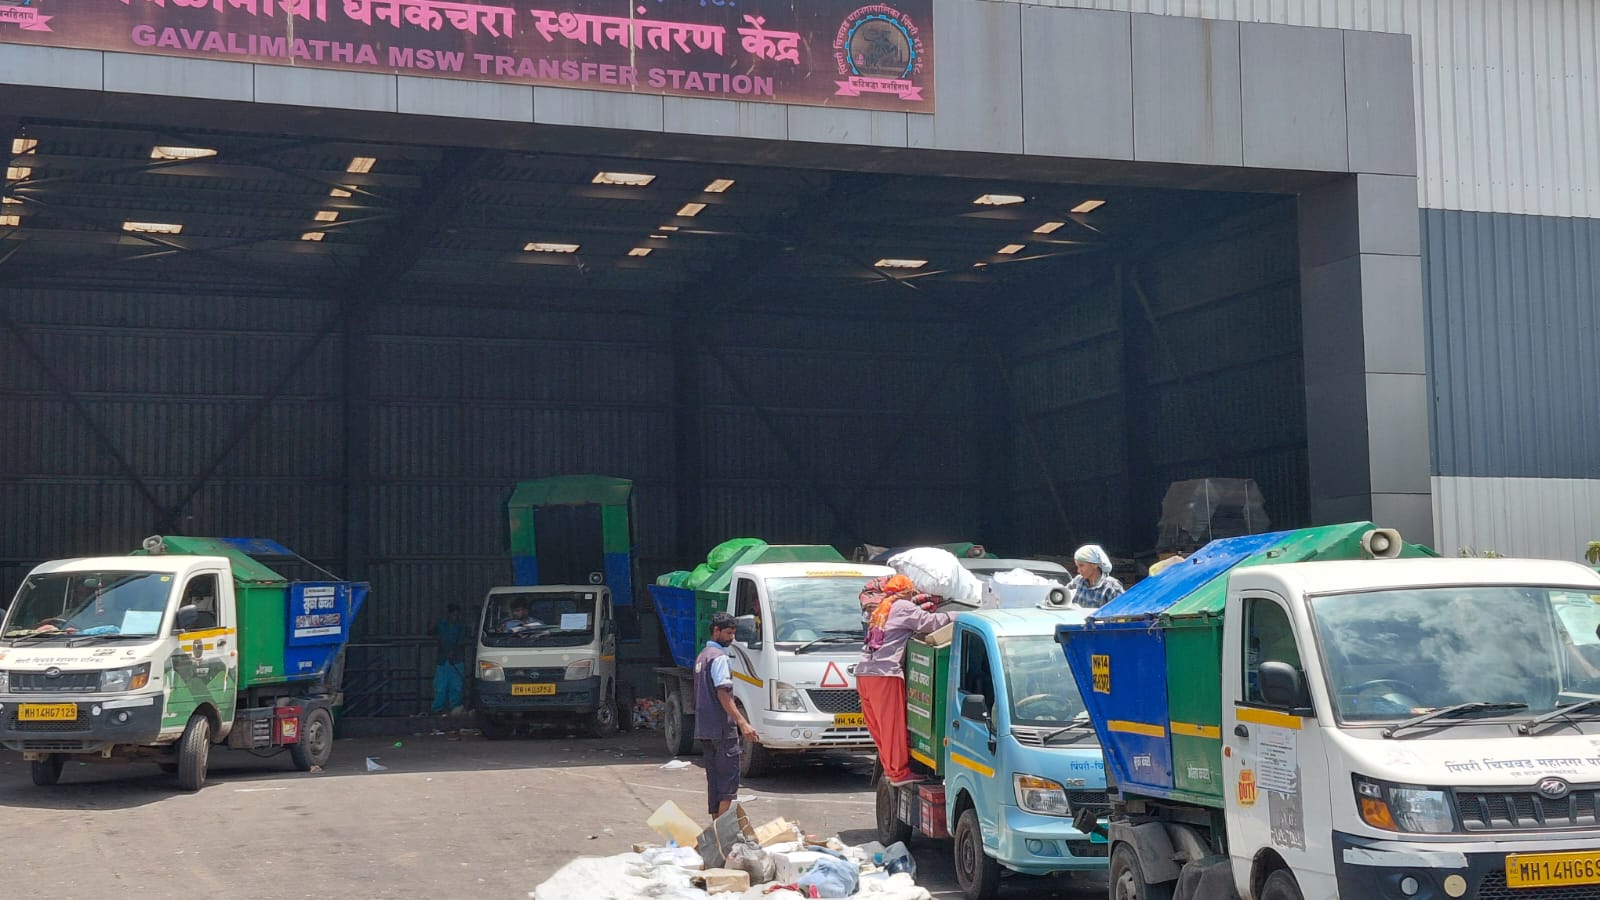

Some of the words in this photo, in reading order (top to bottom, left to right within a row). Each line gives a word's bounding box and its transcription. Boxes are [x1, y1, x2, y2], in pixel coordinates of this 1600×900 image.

[131, 24, 377, 65] GAVALIMATHA
[389, 46, 465, 72] MSW
[473, 53, 638, 86] TRANSFER
[648, 66, 774, 97] STATION
[530, 5, 726, 56] स्थानांतरण
[737, 14, 800, 65] केंद्र
[1238, 781, 1256, 800] DUTY
